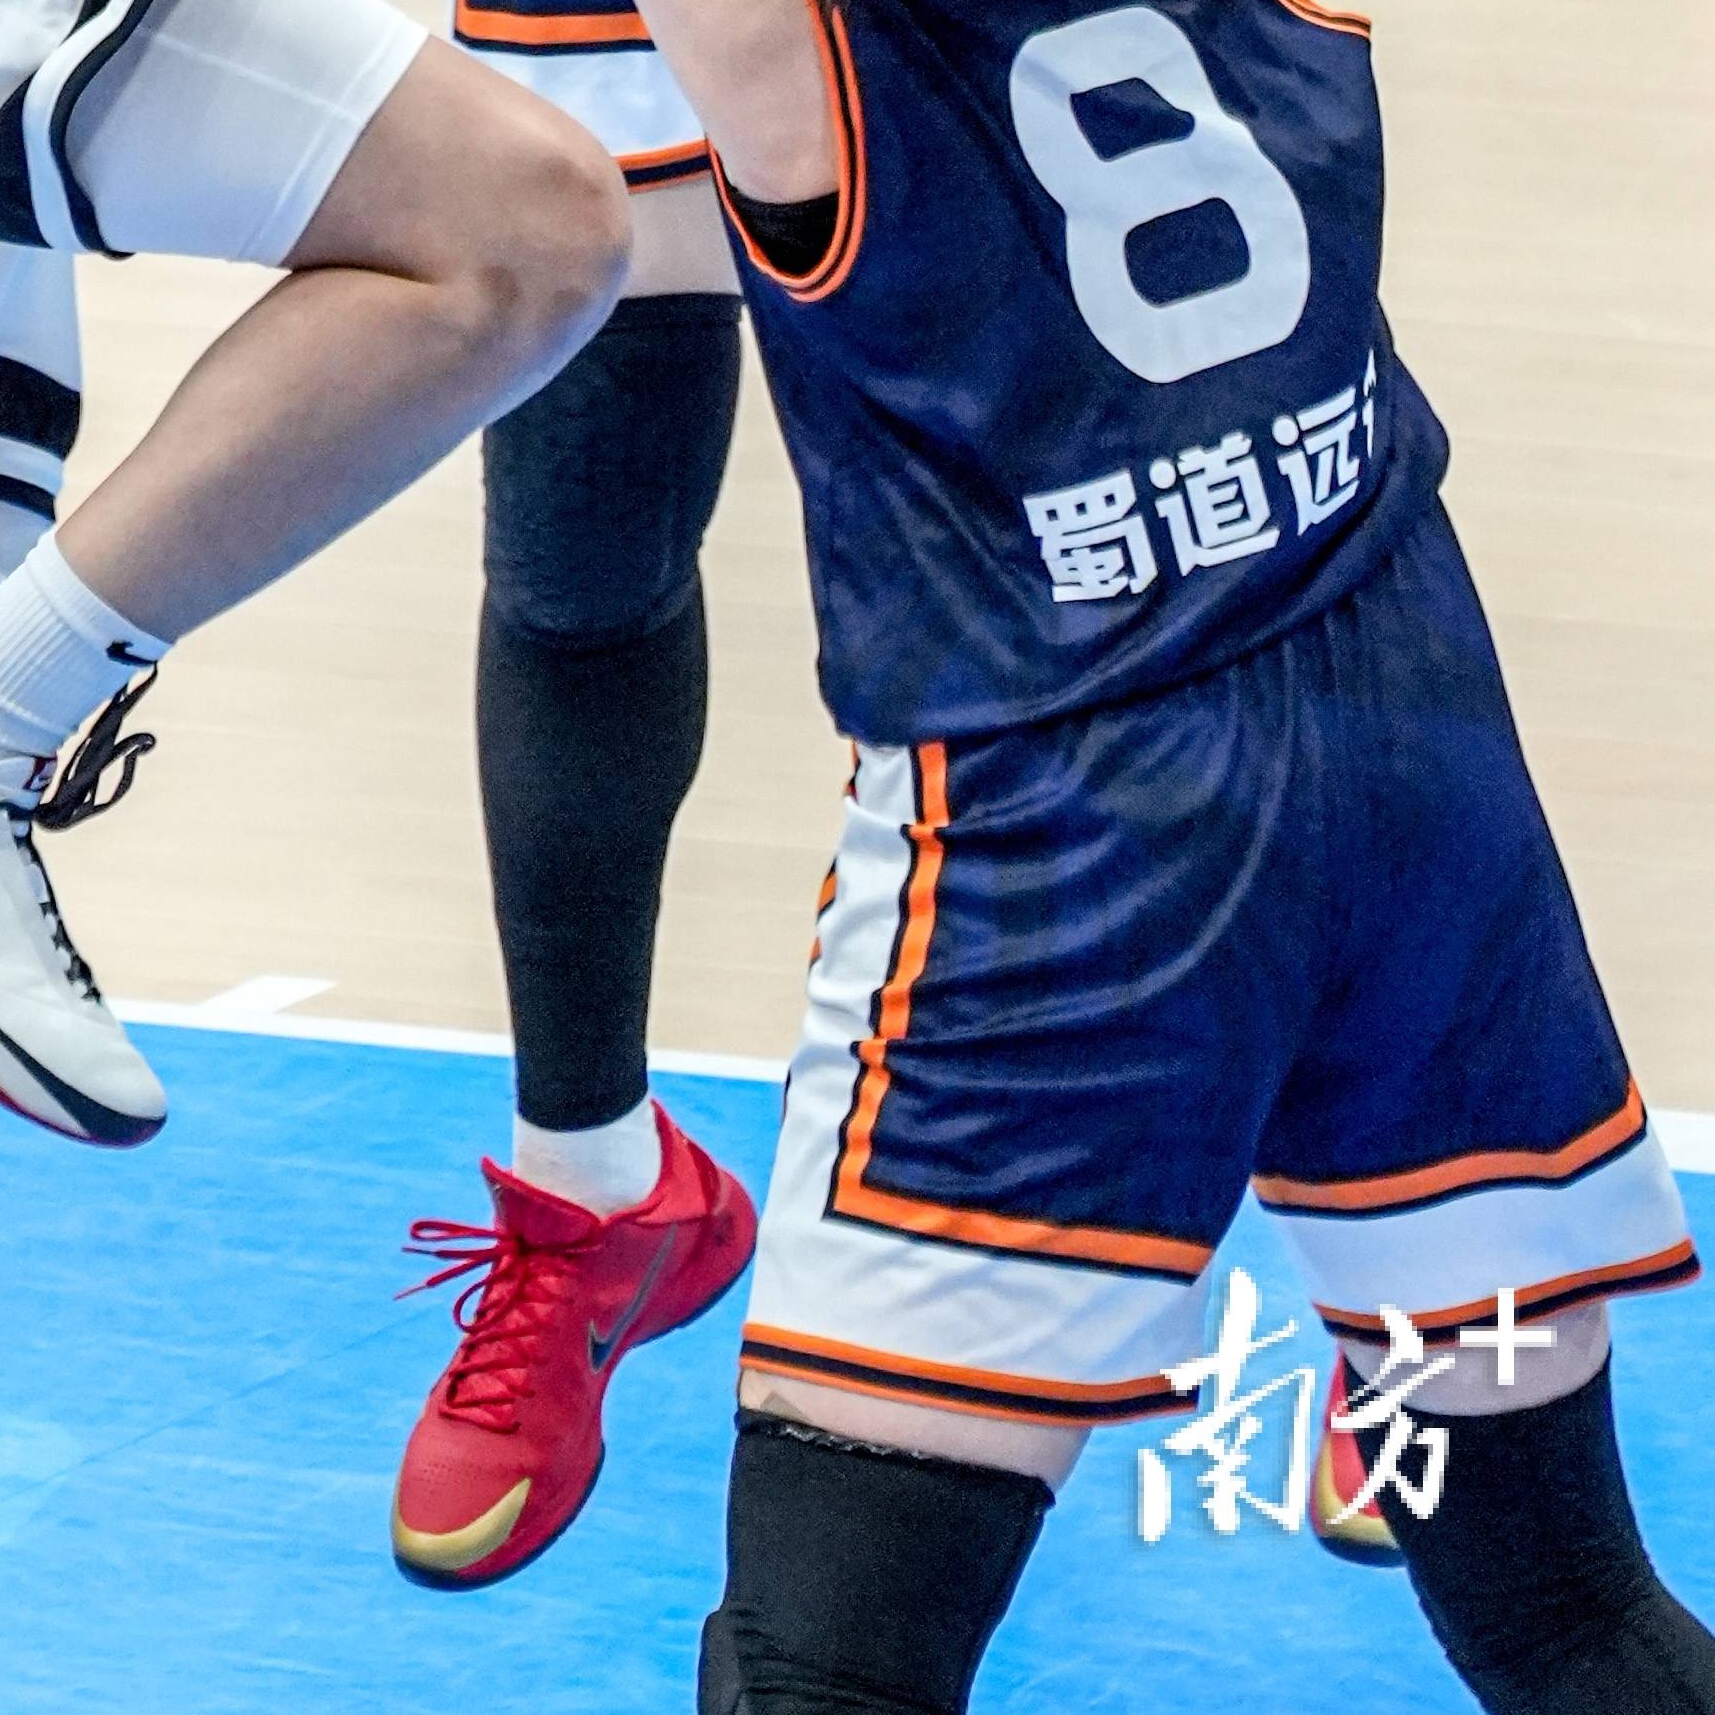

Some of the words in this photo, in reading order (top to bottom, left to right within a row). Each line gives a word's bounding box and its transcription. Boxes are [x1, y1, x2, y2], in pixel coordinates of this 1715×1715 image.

[1008, 5, 1311, 385] 8
[1022, 348, 1377, 603] 蜀道远
